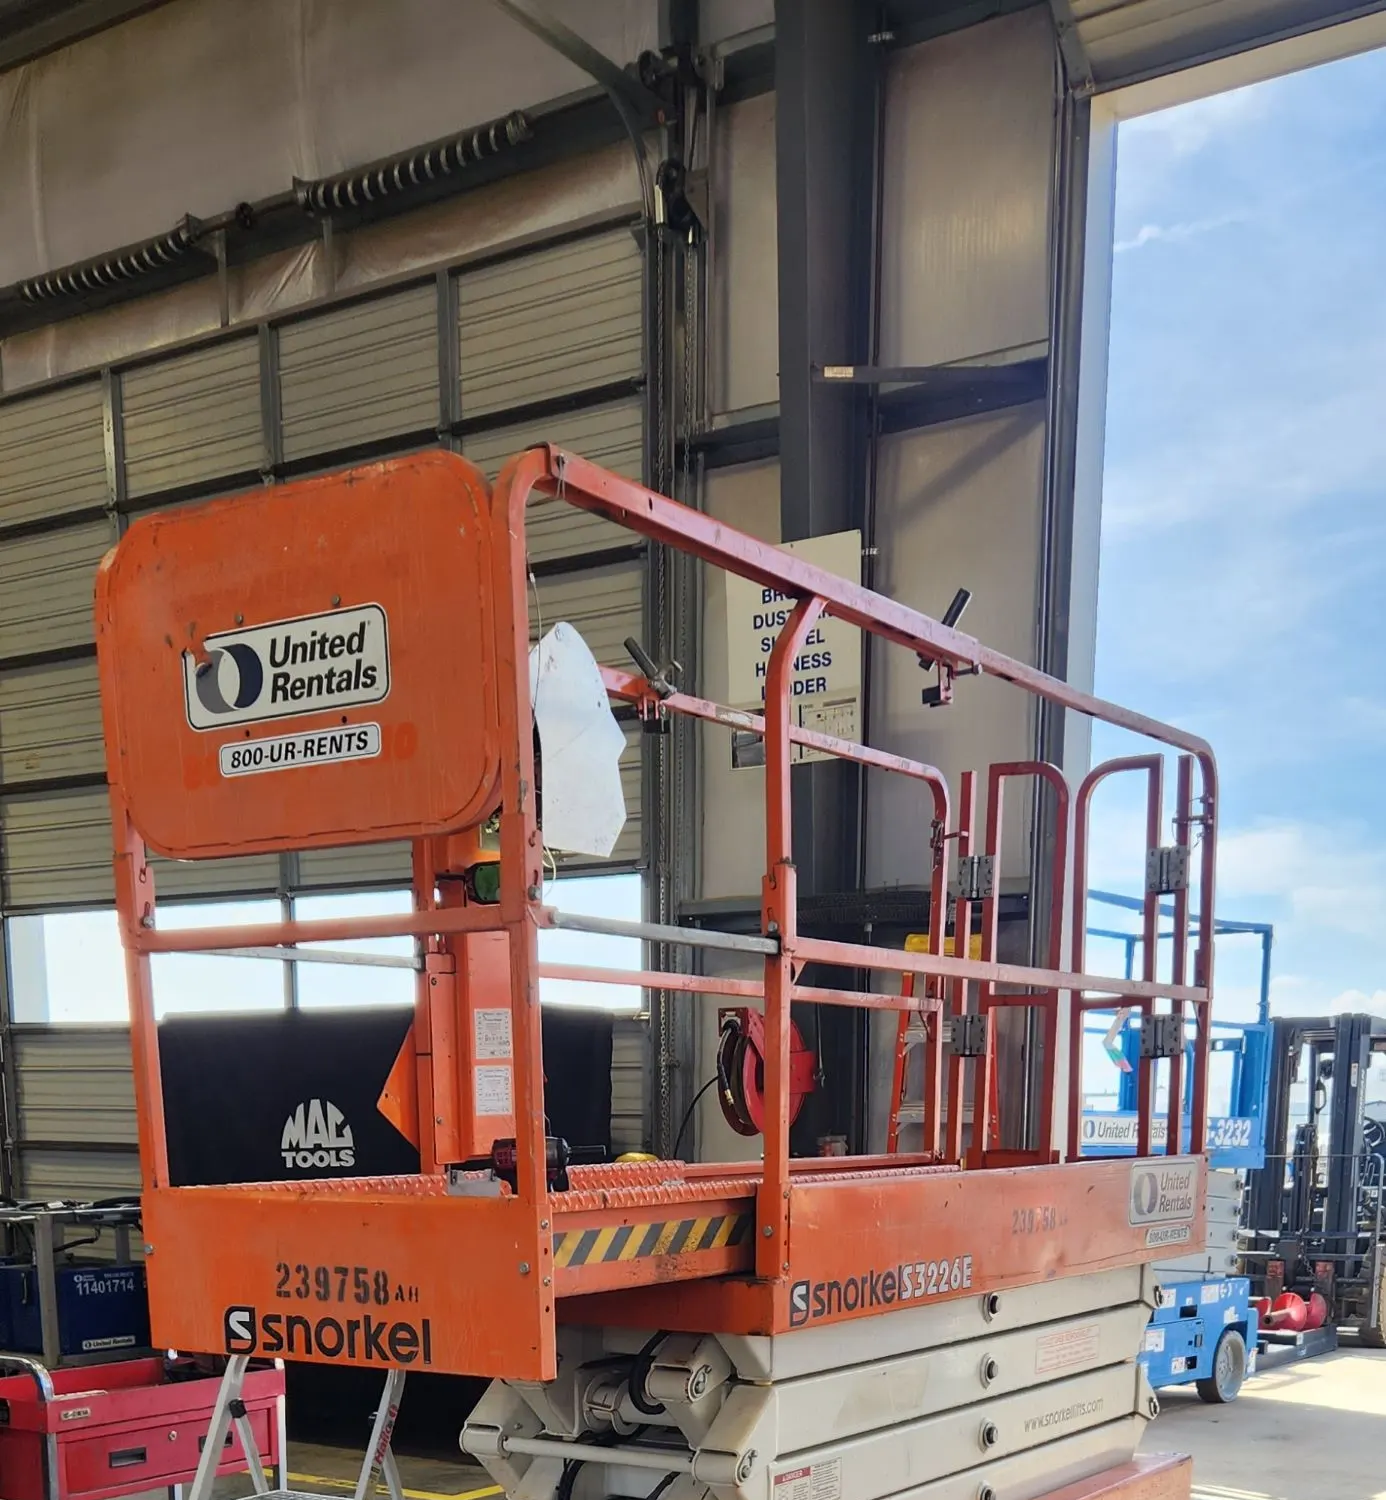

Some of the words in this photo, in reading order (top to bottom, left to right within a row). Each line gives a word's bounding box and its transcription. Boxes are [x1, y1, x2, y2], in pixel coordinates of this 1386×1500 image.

[269, 621, 366, 668] United
[271, 659, 377, 704] Rentals
[755, 651, 833, 678] HNESS
[231, 731, 369, 769] 800-UR-RENTS
[281, 1099, 354, 1149] MAC
[1097, 1119, 1129, 1139] United
[281, 1149, 355, 1168] TOOLS
[1160, 1170, 1191, 1191] United
[1158, 1192, 1192, 1213] Rentals
[77, 1278, 134, 1295] 11401714
[276, 1262, 390, 1306] 239758
[813, 1264, 902, 1318] snorkel
[901, 1255, 973, 1301] S3226E
[262, 1313, 431, 1365] snorkel
